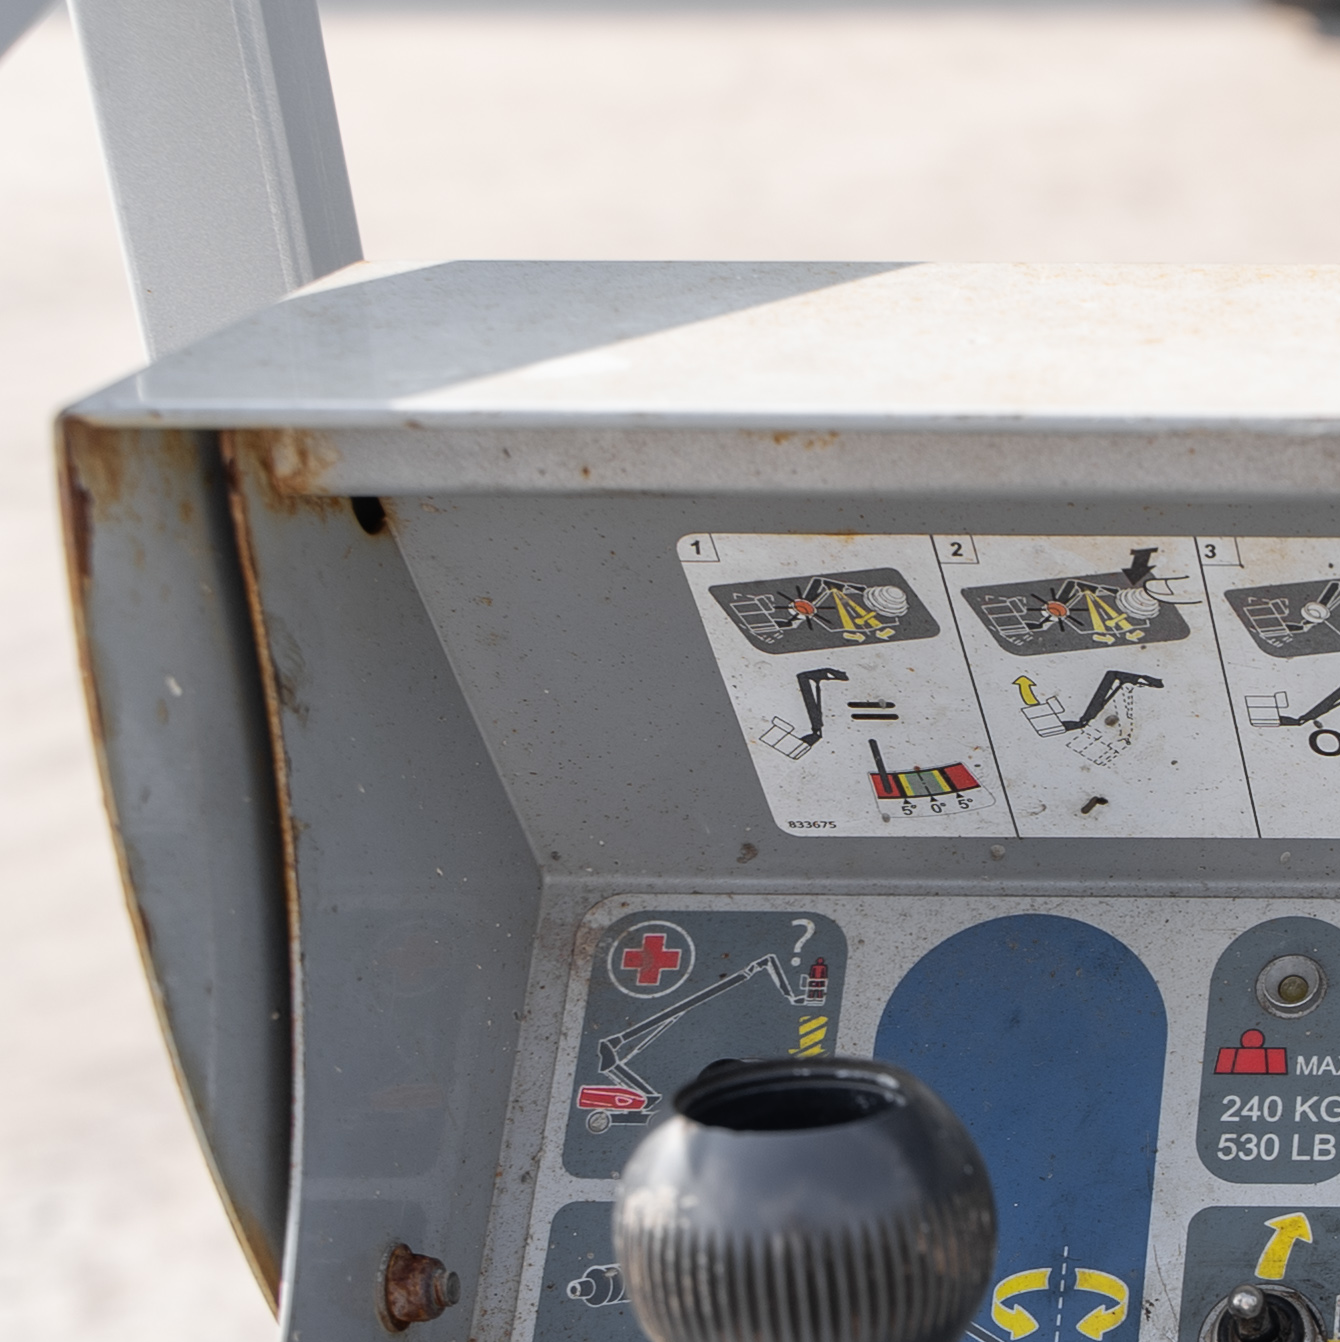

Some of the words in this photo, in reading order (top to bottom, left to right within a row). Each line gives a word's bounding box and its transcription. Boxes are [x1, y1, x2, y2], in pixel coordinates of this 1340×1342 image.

[690, 540, 702, 556] 1
[950, 541, 964, 557] 2
[1204, 543, 1217, 559] 3
[787, 820, 837, 829] 833675
[1220, 1095, 1284, 1123] 240
[1217, 1133, 1280, 1161] 530
[1291, 1133, 1337, 1161] LB
